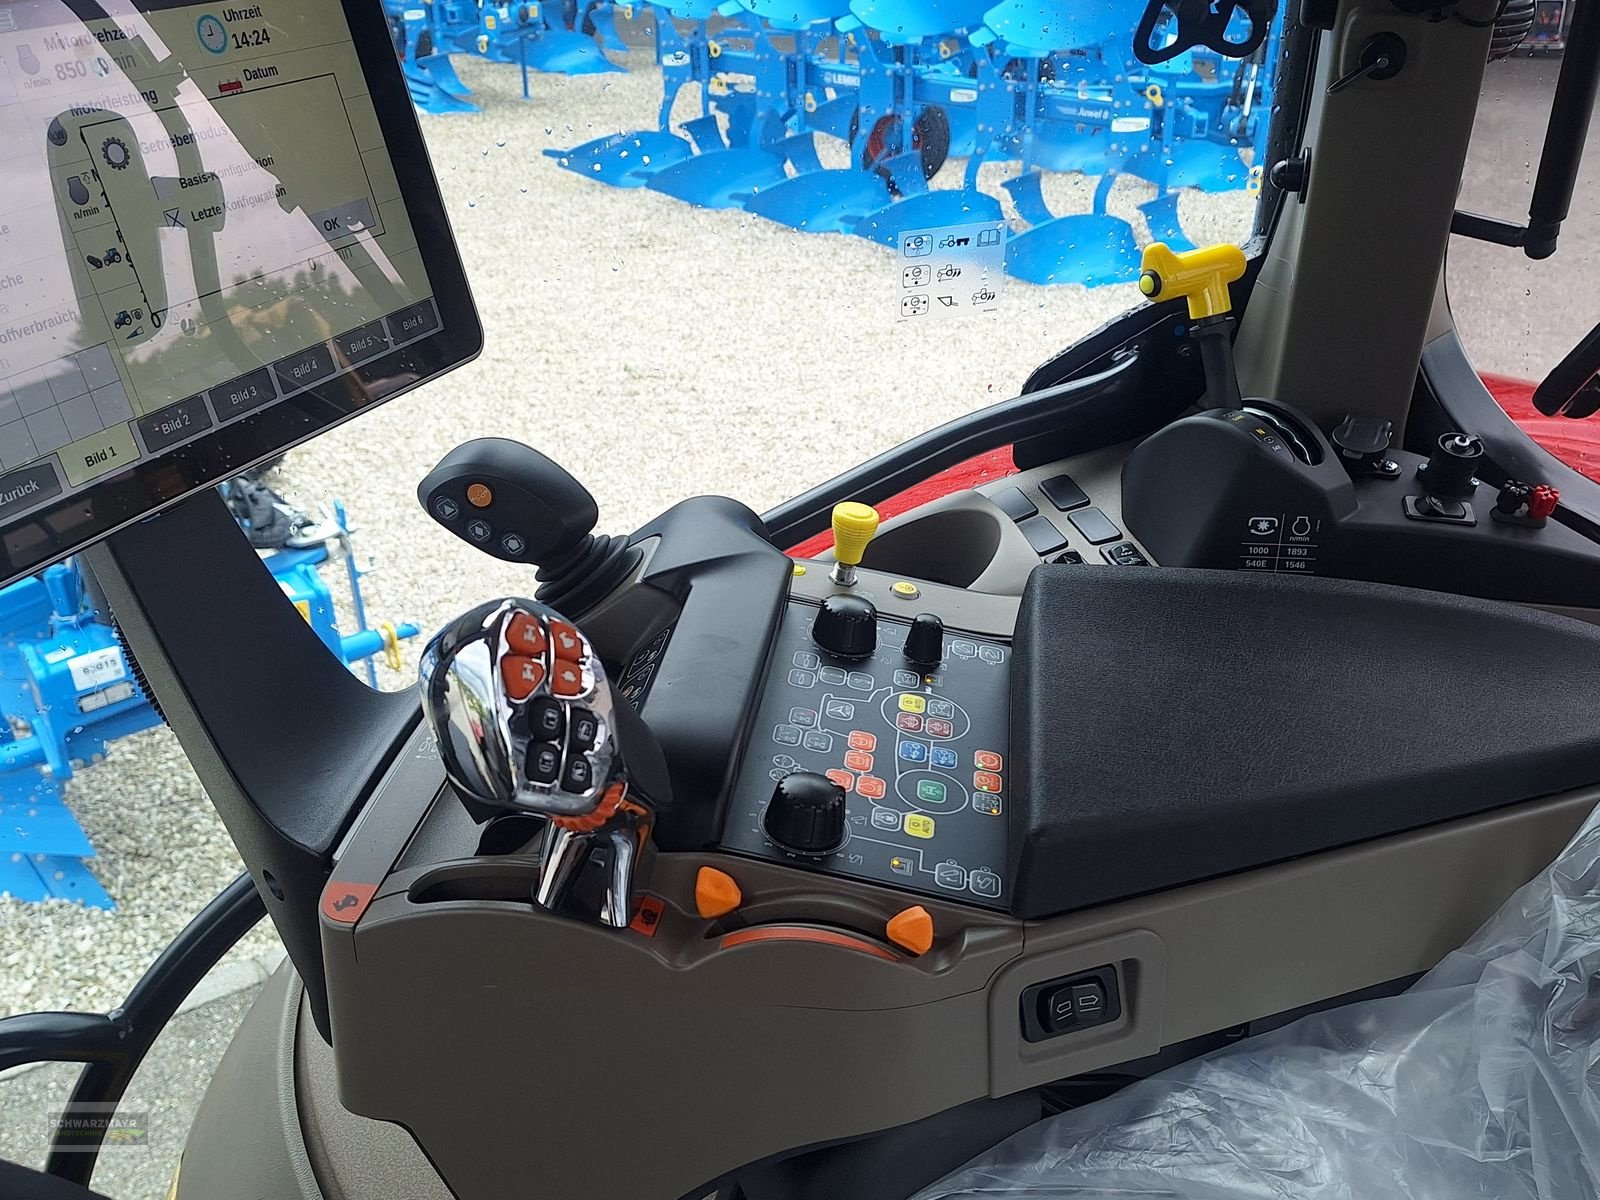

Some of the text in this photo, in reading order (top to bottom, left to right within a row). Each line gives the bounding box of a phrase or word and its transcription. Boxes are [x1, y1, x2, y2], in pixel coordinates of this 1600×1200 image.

[222, 5, 262, 23] Uhrzeit
[43, 24, 138, 51] Motordrehzahl
[231, 28, 271, 50] 14:24
[55, 60, 88, 81] 850
[242, 64, 279, 82] Datum
[68, 88, 159, 118] Motorleistung
[140, 125, 228, 154] Getriebemodus
[179, 156, 275, 189] Basis-Konfiguration
[73, 206, 100, 220] n/min
[191, 186, 287, 222] Letzte Konfiguration
[323, 217, 341, 232] OK
[402, 314, 423, 331] Bild 6
[350, 336, 373, 353] Bild 5
[293, 360, 318, 378] Bild 4
[230, 386, 257, 405] Bild 3
[161, 414, 191, 435] Bild 2
[84, 446, 117, 468] Bild 1
[1249, 546, 1308, 556] 1000 1893
[1245, 560, 1306, 569] 540E 1546
[922, 820, 931, 834] AUTO
